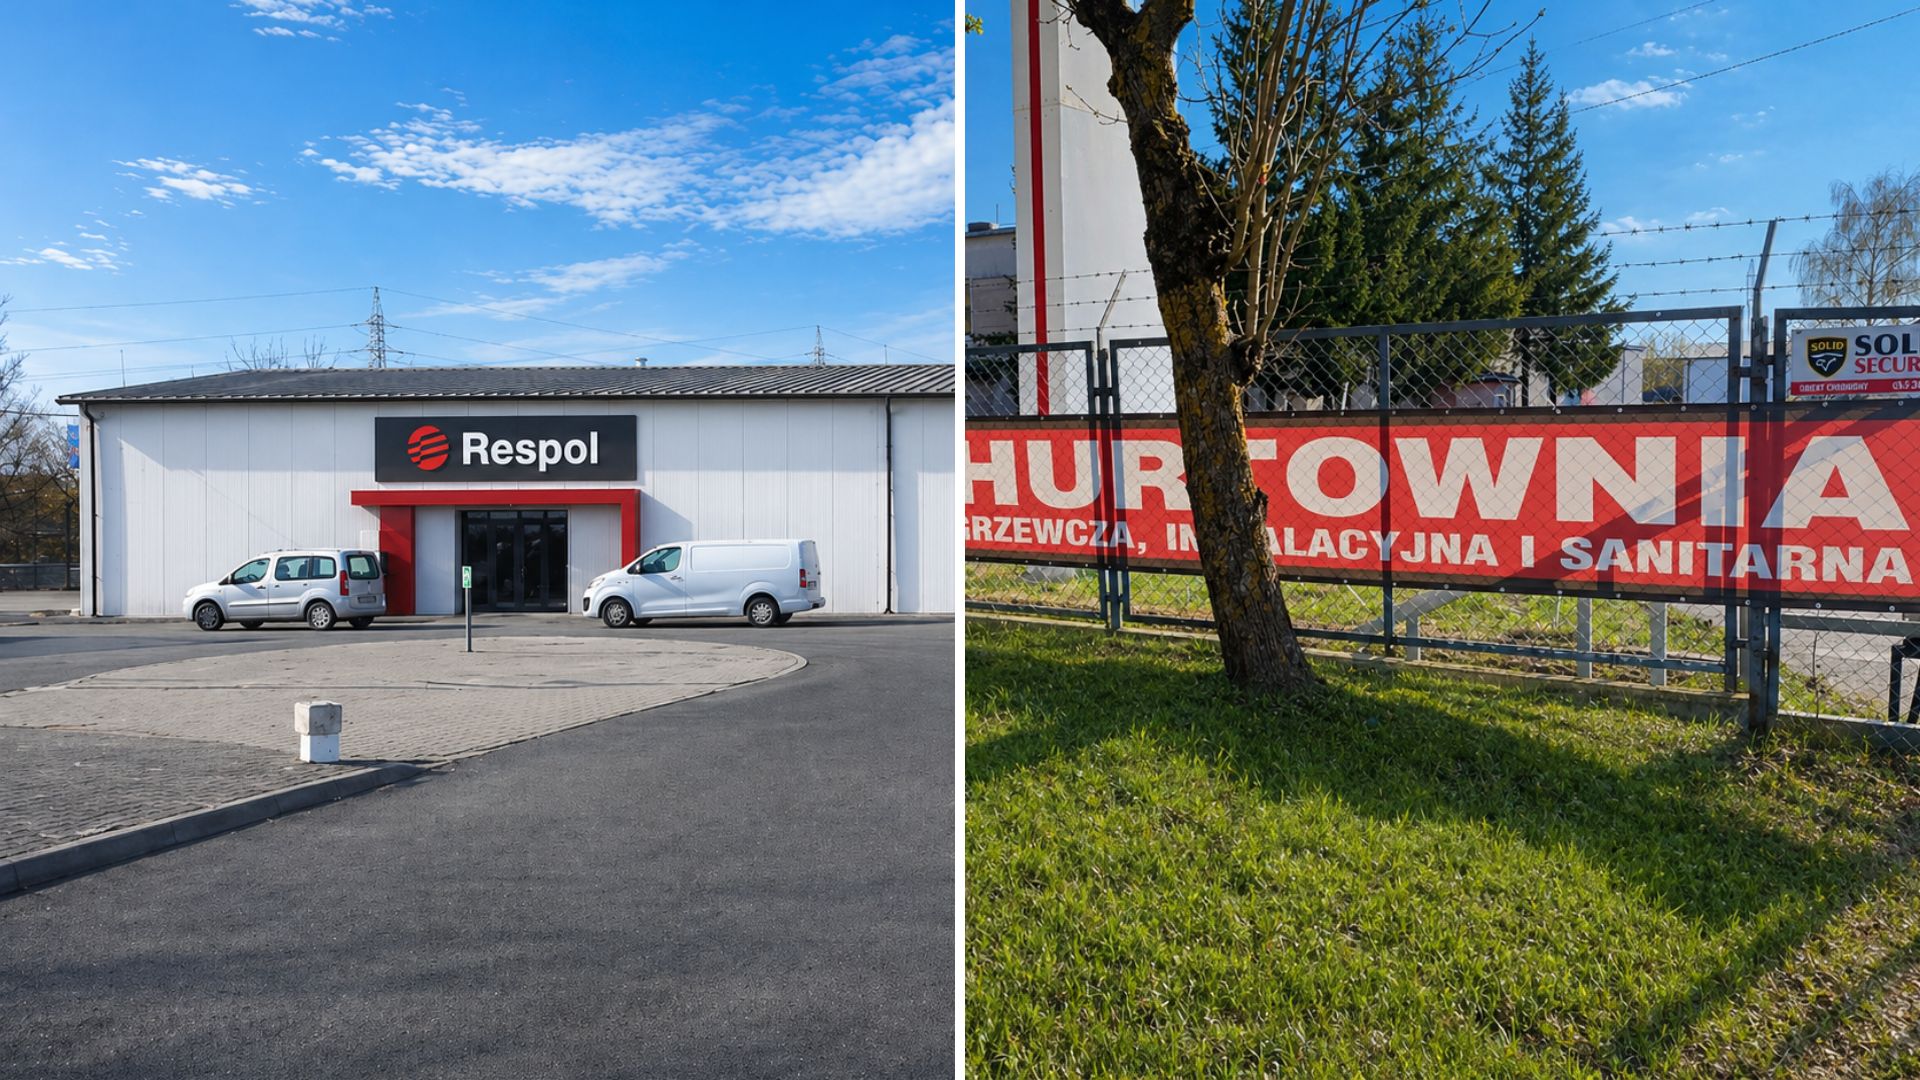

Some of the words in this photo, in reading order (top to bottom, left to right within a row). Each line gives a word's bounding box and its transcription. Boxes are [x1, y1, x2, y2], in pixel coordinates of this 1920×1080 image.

[1811, 341, 1844, 351] SOLID
[1855, 333, 1920, 356] SOL
[462, 431, 598, 472] Respol
[965, 515, 1146, 555] RZEWCZA,
[1166, 522, 1499, 567] INLACYJNA
[1521, 535, 1535, 568] I
[1560, 536, 1914, 585] SANITARNA
